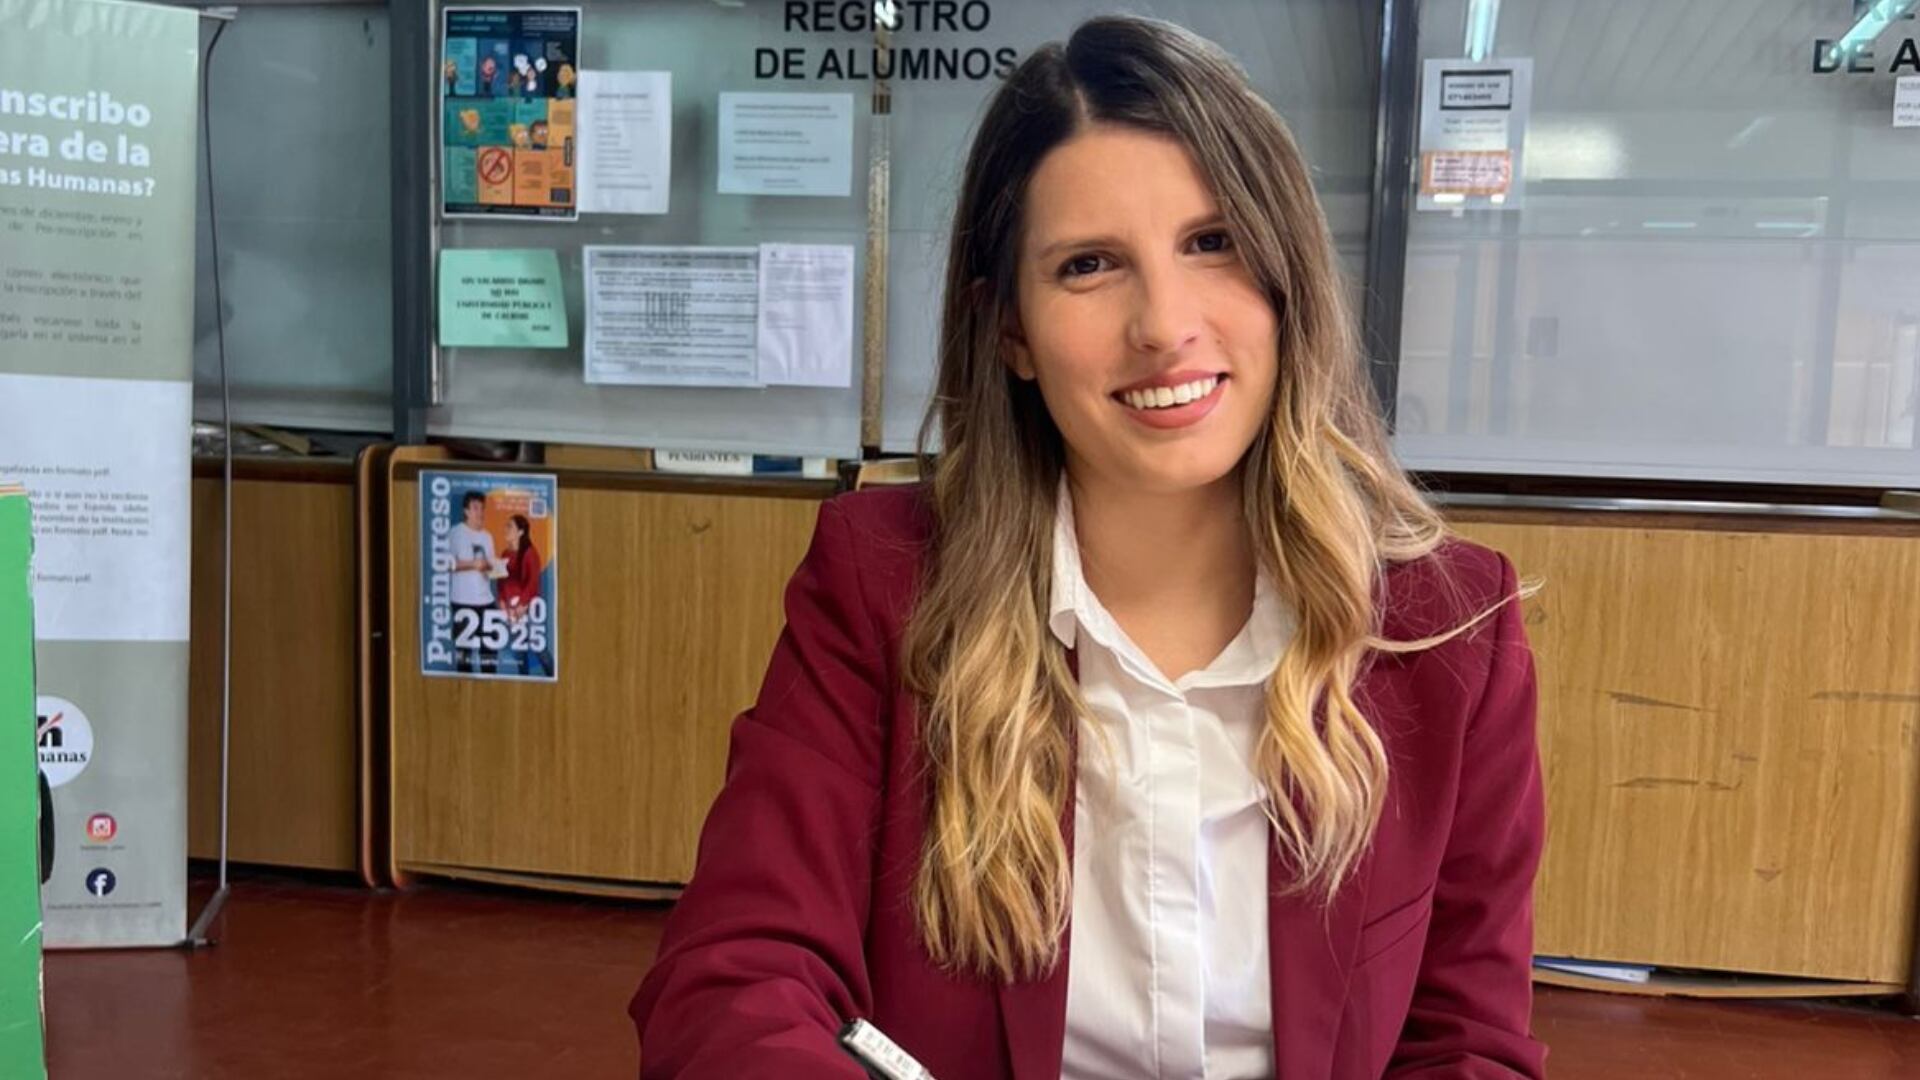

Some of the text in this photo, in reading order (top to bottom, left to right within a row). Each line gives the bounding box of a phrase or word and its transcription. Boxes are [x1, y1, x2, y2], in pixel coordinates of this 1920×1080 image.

[755, 46, 1018, 80] DE ALUMNOS
[1813, 39, 1875, 73] DE
[60, 130, 108, 163] de
[118, 134, 150, 167] la
[28, 167, 156, 197] Humanas?
[424, 476, 457, 665] Preingreso
[453, 609, 510, 652] 25
[510, 624, 547, 653] 25
